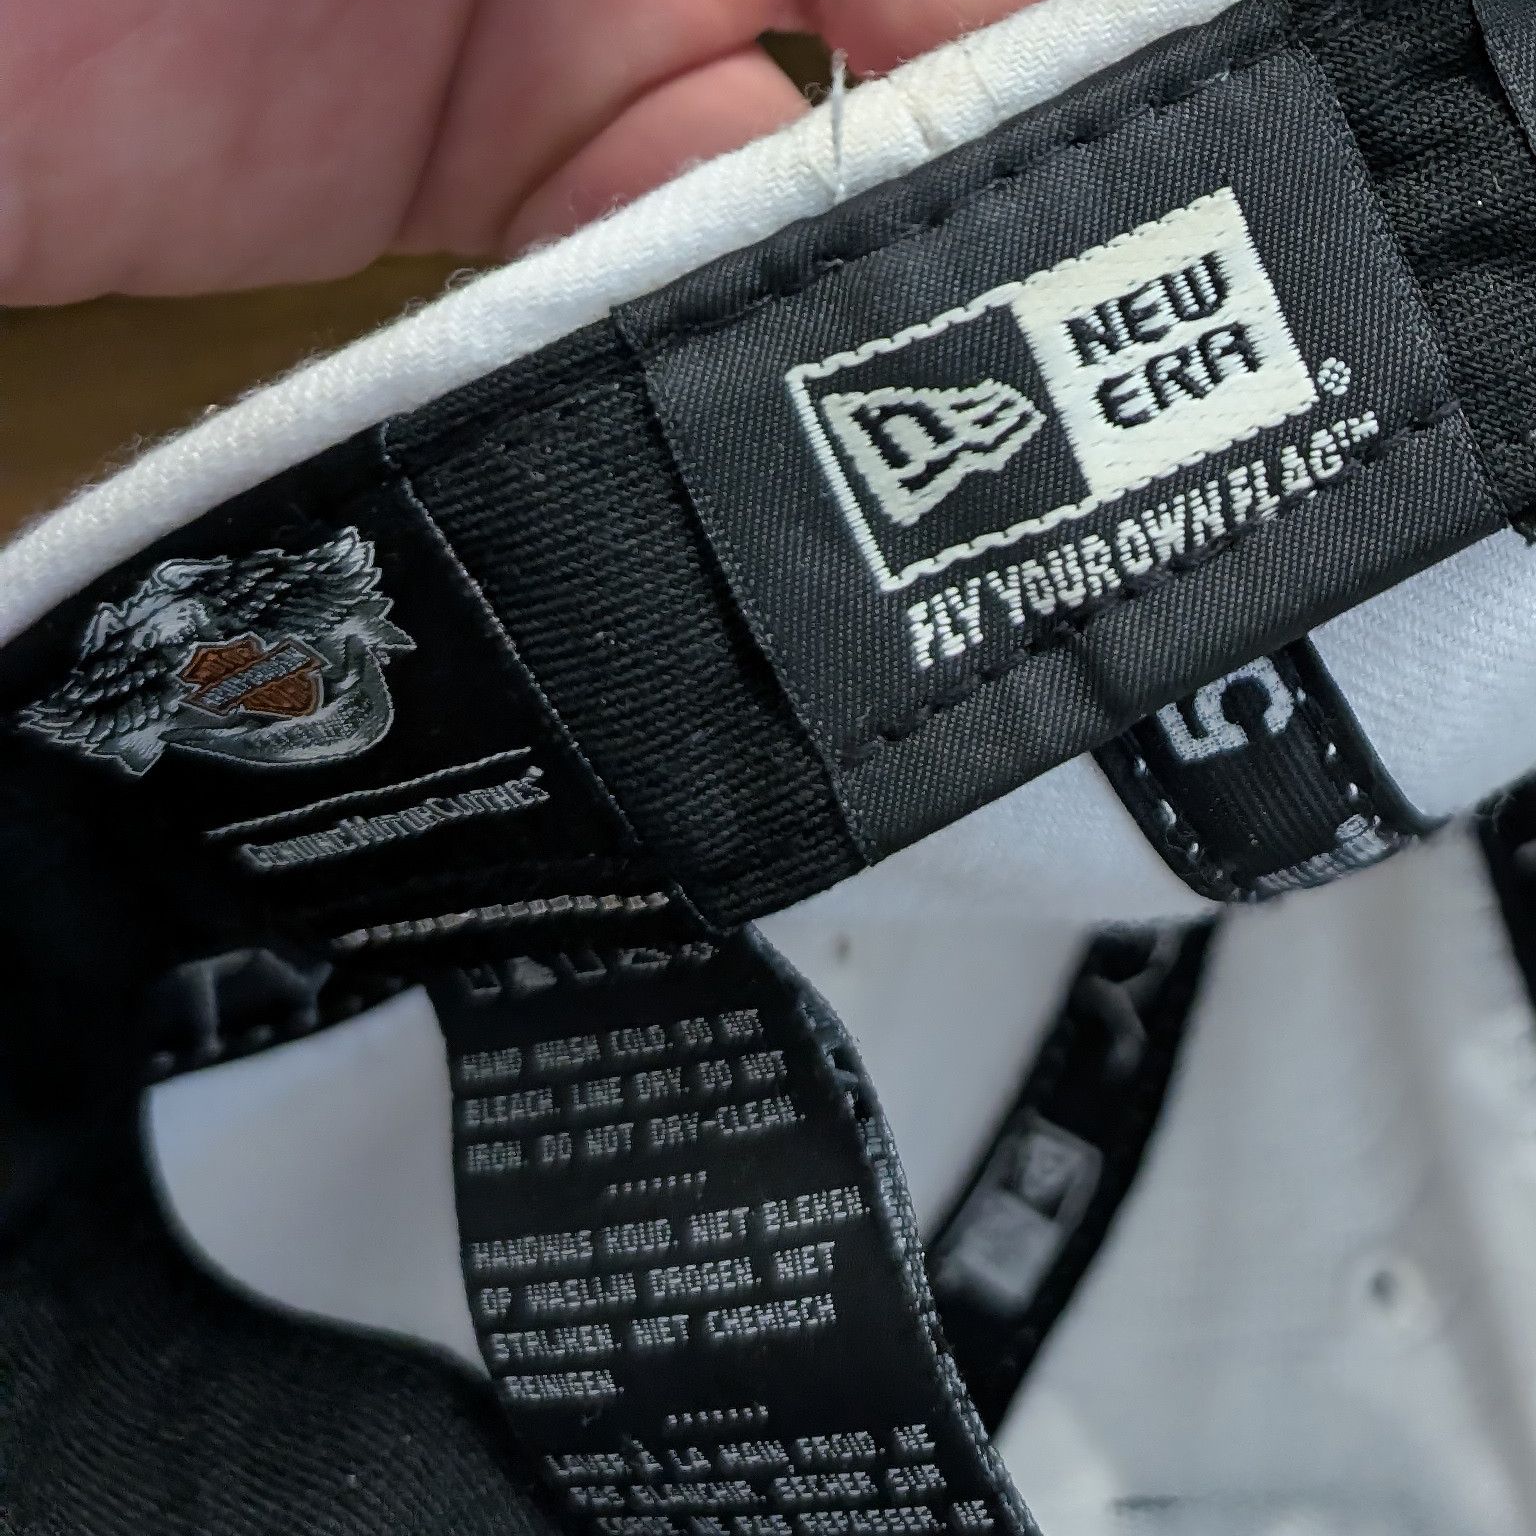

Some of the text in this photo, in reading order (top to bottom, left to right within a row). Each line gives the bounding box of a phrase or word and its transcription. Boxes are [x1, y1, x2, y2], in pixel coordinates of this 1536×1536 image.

[1064, 250, 1231, 368] NEW
[1095, 321, 1264, 430] ERA
[906, 578, 984, 669] FLY
[989, 534, 1121, 628] YOUR
[1117, 478, 1228, 578] OWN
[674, 1016, 713, 1047] DO
[717, 1007, 764, 1040] NOT
[569, 1075, 625, 1113] LINE
[697, 1058, 734, 1091] DO
[740, 1049, 788, 1082] NOT
[541, 1132, 573, 1165] DO
[584, 1122, 635, 1159] NOT
[687, 1206, 750, 1243] NIET
[479, 1286, 513, 1319] OP
[772, 1240, 837, 1282] NIET
[631, 1313, 690, 1347] NIET
